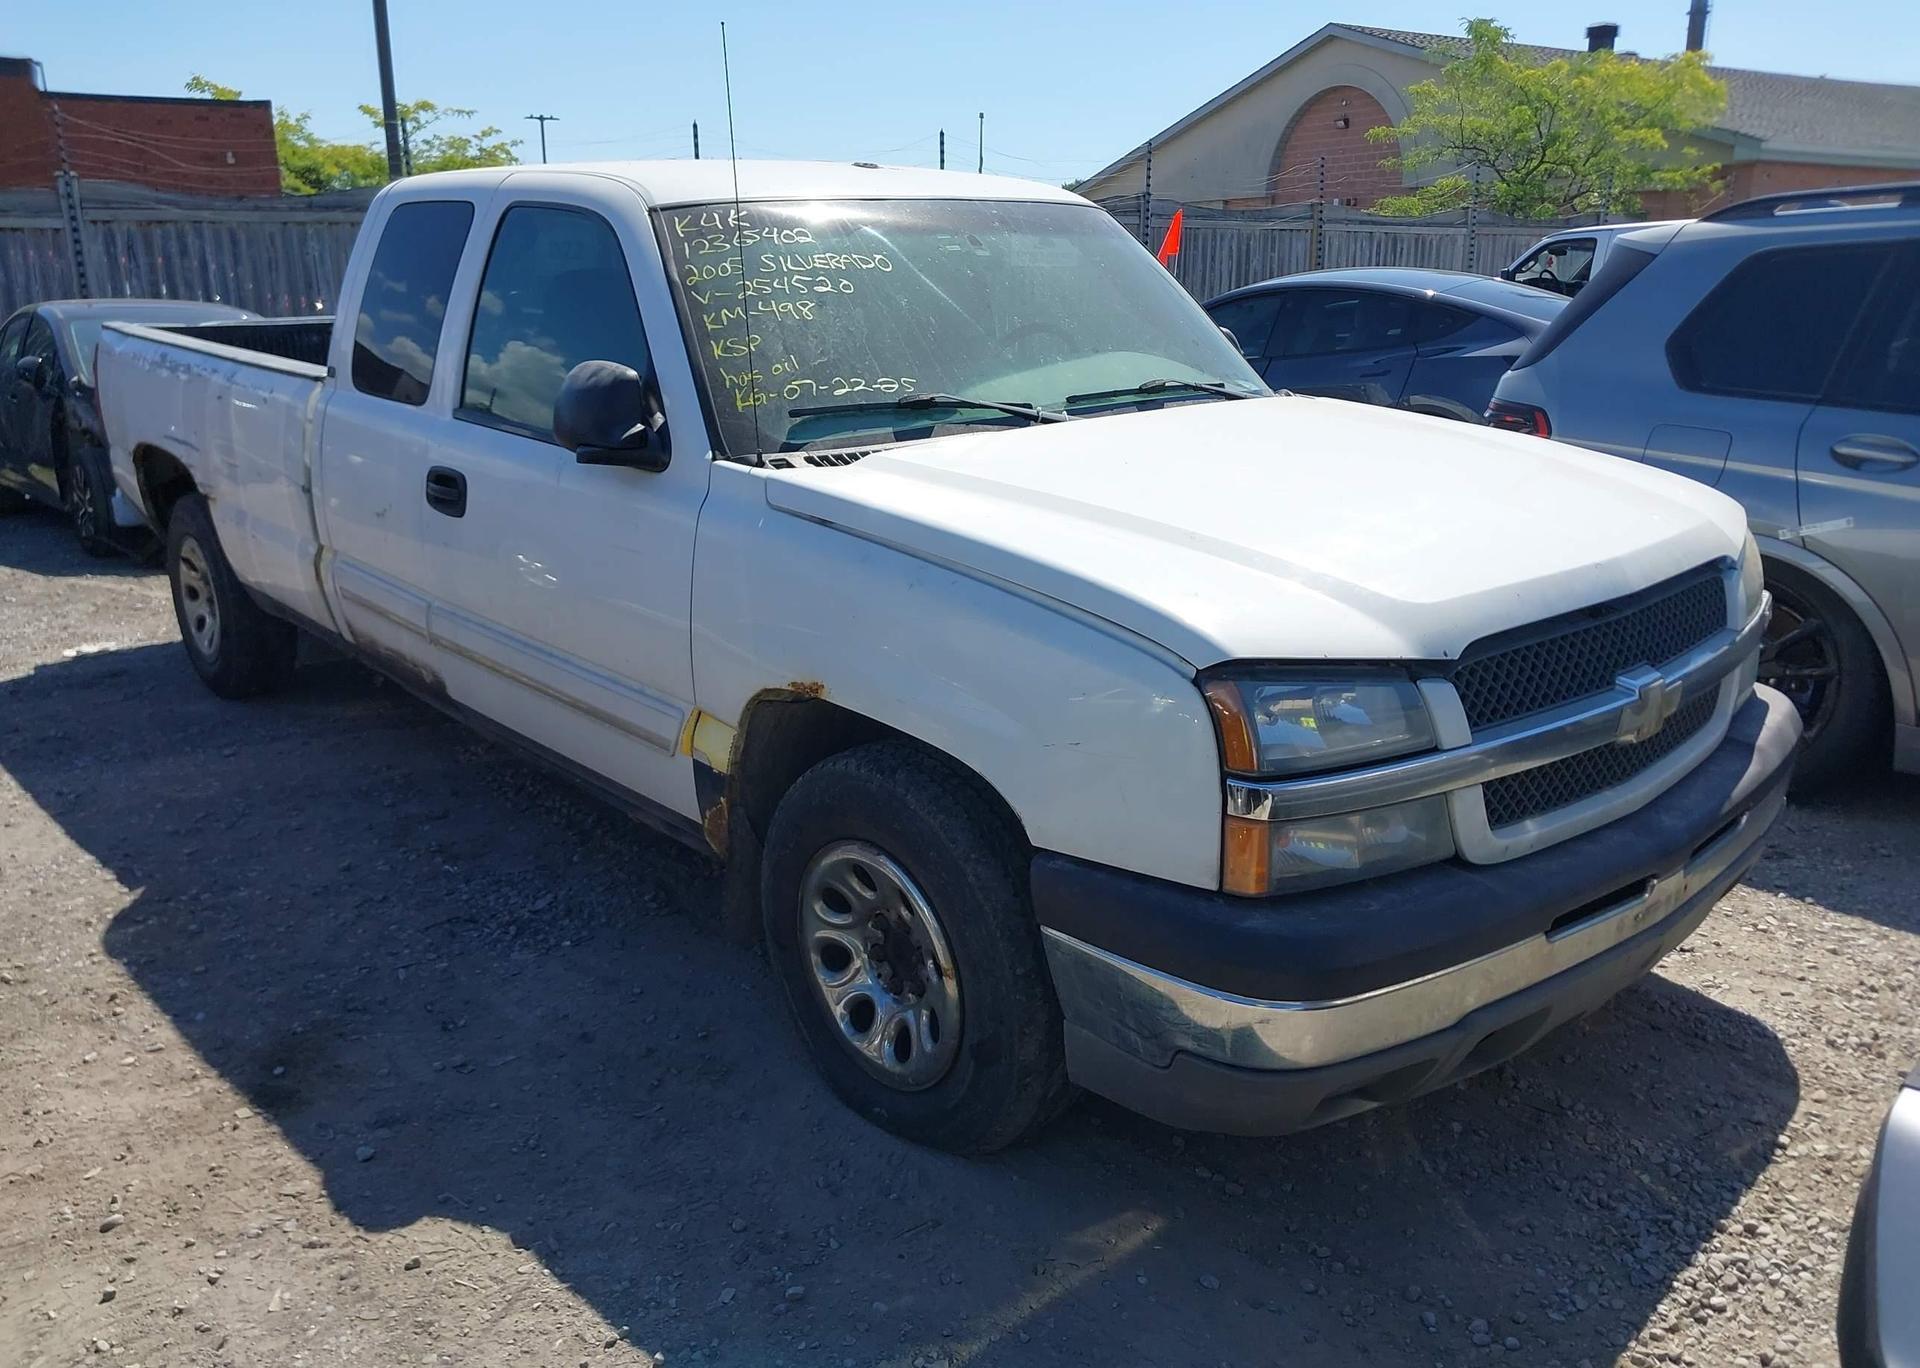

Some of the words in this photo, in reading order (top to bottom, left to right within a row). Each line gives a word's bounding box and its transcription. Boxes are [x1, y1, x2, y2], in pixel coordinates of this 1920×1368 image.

[685, 256, 745, 286] 2005
[760, 253, 893, 273] SILVERADO
[710, 335, 762, 360] KSP
[771, 354, 800, 375] oil
